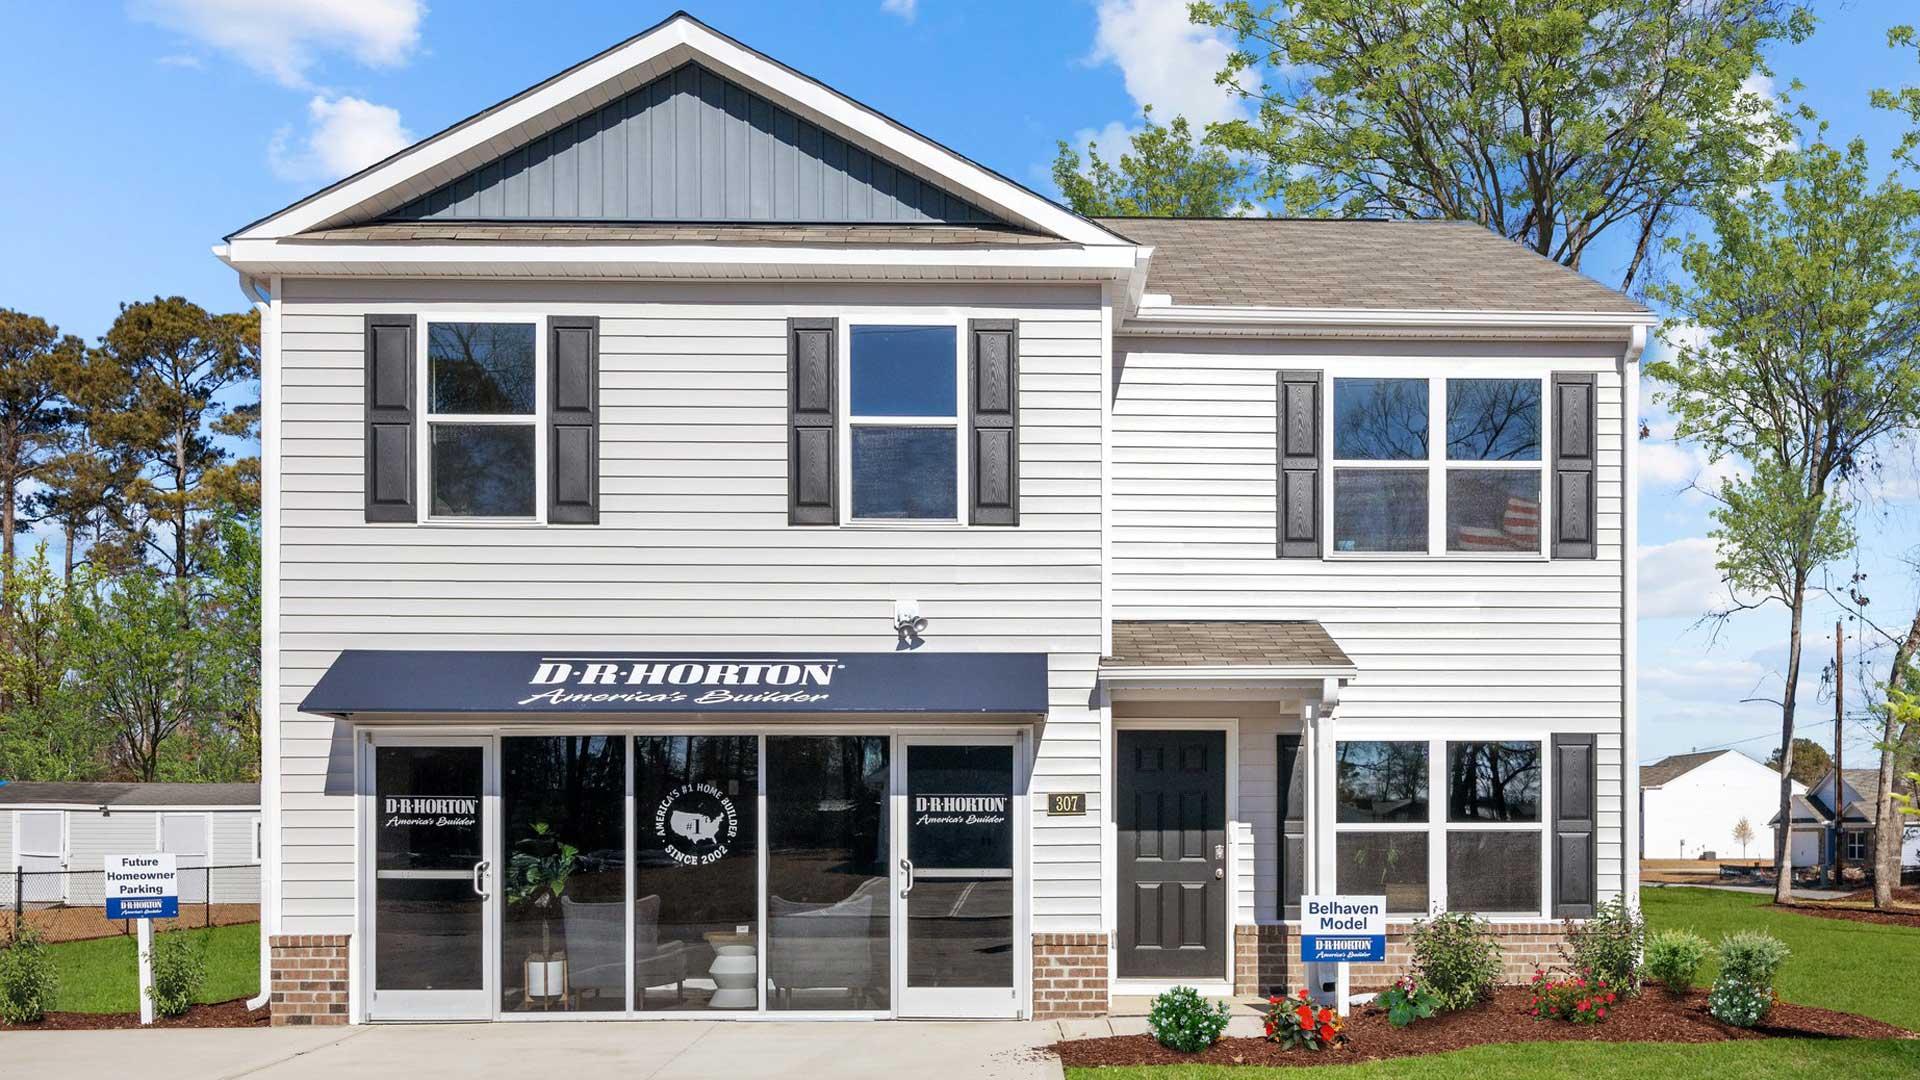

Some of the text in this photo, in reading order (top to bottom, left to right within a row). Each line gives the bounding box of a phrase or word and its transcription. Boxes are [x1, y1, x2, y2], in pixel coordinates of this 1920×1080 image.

[518, 688, 829, 705] America's Builder
[655, 783, 738, 838] AMERICA'S #1 HOME BUILDER
[1056, 796, 1078, 812] 307
[385, 815, 476, 827] America's Builder
[686, 818, 702, 834] #1
[916, 814, 1005, 825] America's Builder
[664, 844, 728, 866] SINCE 2002
[122, 858, 159, 867] Future
[107, 872, 175, 881] Homeowner
[120, 884, 163, 895] Parking
[1308, 901, 1379, 915] Belhaven
[1320, 917, 1367, 930] Model
[1315, 951, 1346, 959] America's
